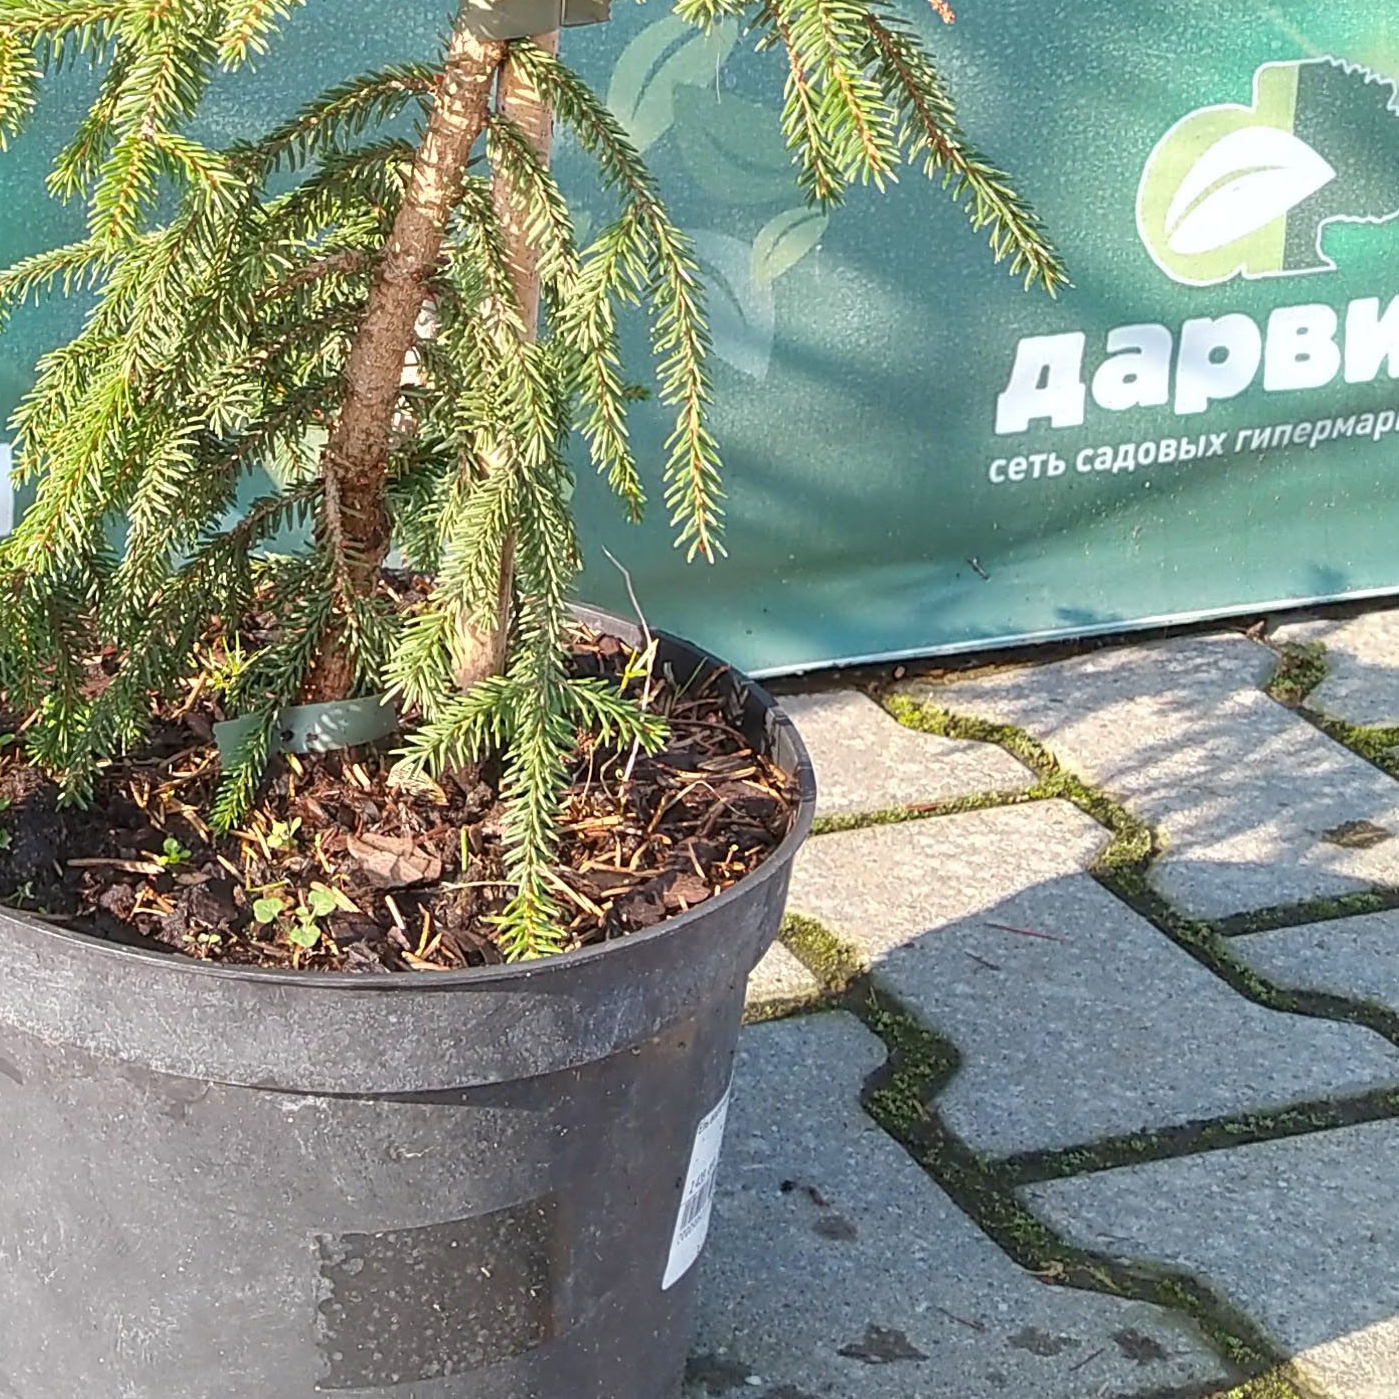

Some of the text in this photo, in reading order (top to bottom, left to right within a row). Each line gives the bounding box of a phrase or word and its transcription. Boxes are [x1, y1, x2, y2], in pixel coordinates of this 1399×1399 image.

[989, 409, 1399, 483] сеть садовых гипермар
